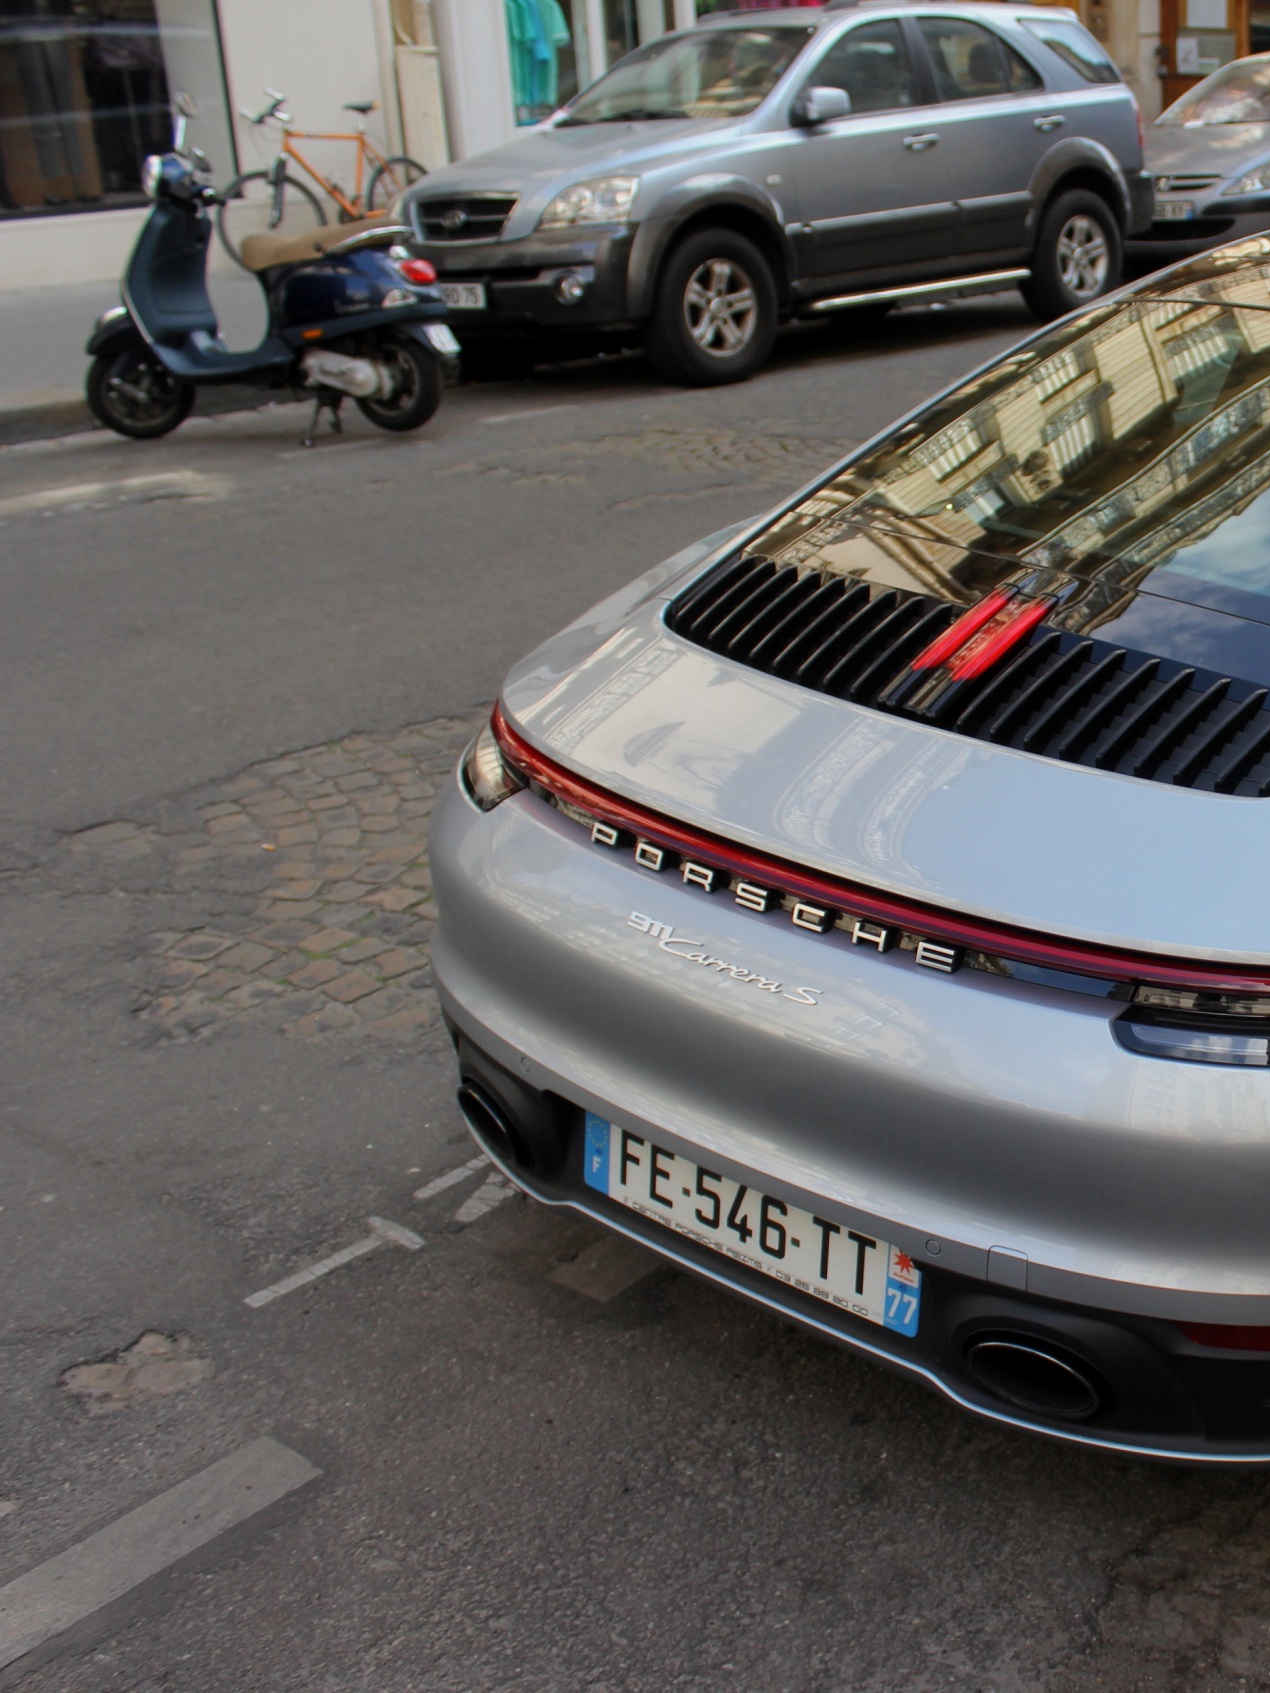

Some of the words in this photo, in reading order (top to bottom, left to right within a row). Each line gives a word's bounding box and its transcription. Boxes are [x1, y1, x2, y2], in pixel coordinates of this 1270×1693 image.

[591, 822, 956, 974] PORSCHE
[626, 911, 674, 940] 911
[658, 937, 783, 993] Carrera
[783, 986, 823, 1005] S
[592, 1155, 601, 1173] F
[620, 1129, 877, 1295] FE-546-TT
[674, 1222, 723, 1251] PORSCHE
[726, 1247, 762, 1270] REIMS
[887, 1287, 917, 1325] 77
